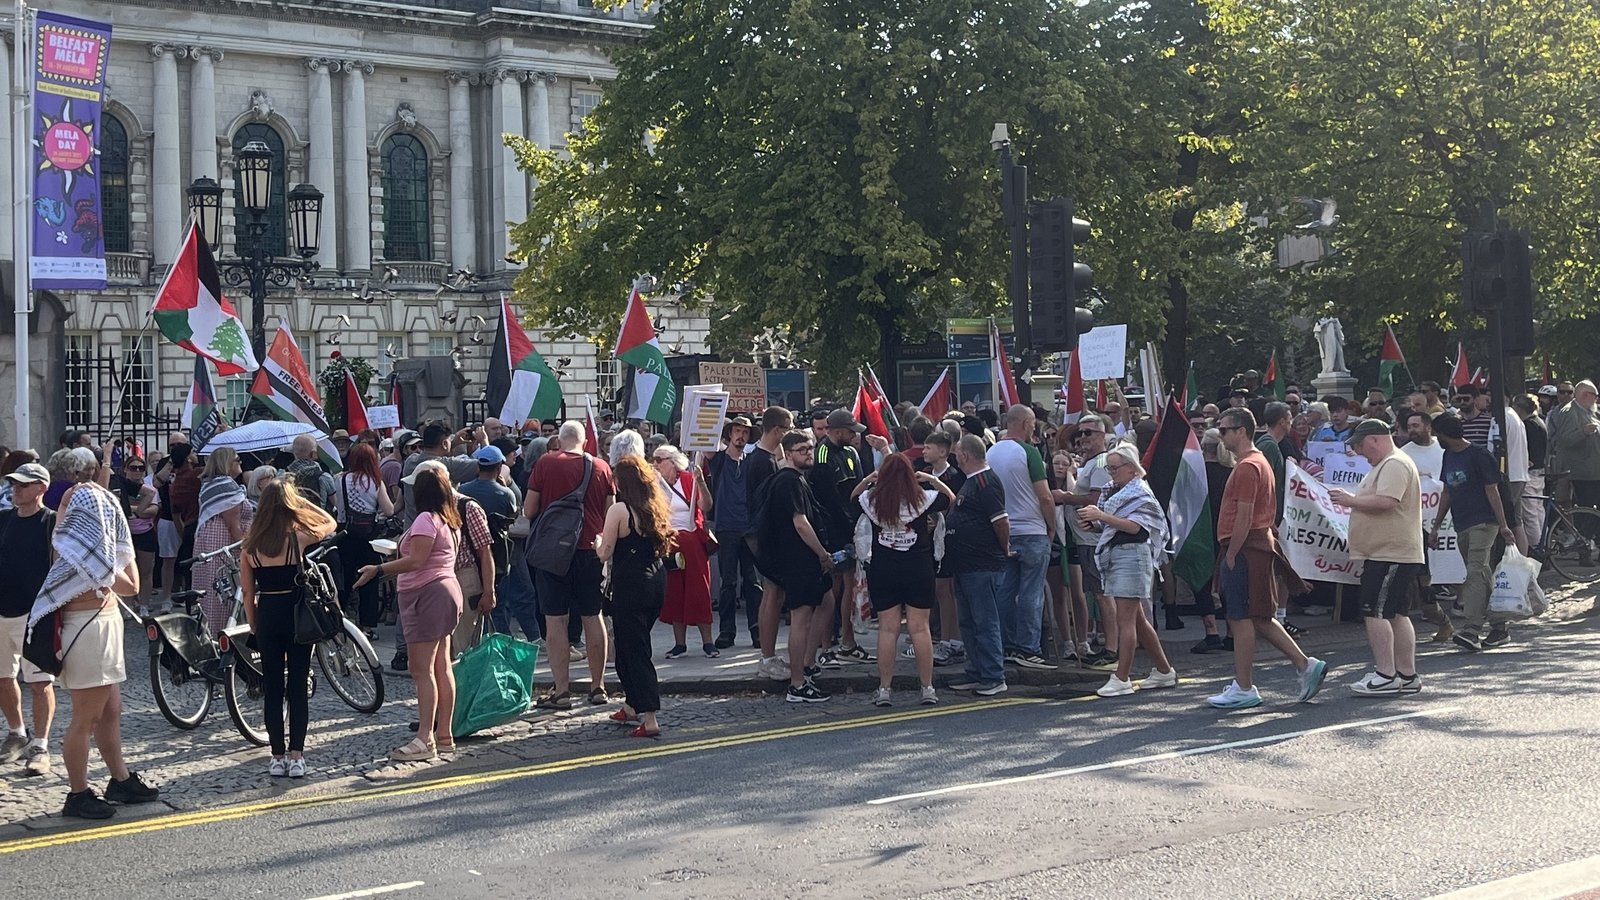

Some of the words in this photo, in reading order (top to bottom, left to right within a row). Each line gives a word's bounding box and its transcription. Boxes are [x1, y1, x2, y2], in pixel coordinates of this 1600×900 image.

[49, 34, 95, 54] BELFAST
[54, 48, 86, 65] MELA
[55, 129, 79, 140] MELA
[58, 140, 77, 150] DAY
[277, 369, 301, 390] FREE
[703, 365, 760, 378] PALESTINE
[646, 357, 676, 412] PALTINE
[735, 388, 761, 396] ACTION
[728, 398, 762, 409] OCIDE
[1286, 506, 1311, 523] FOM
[1286, 525, 1350, 554] PLESTIN
